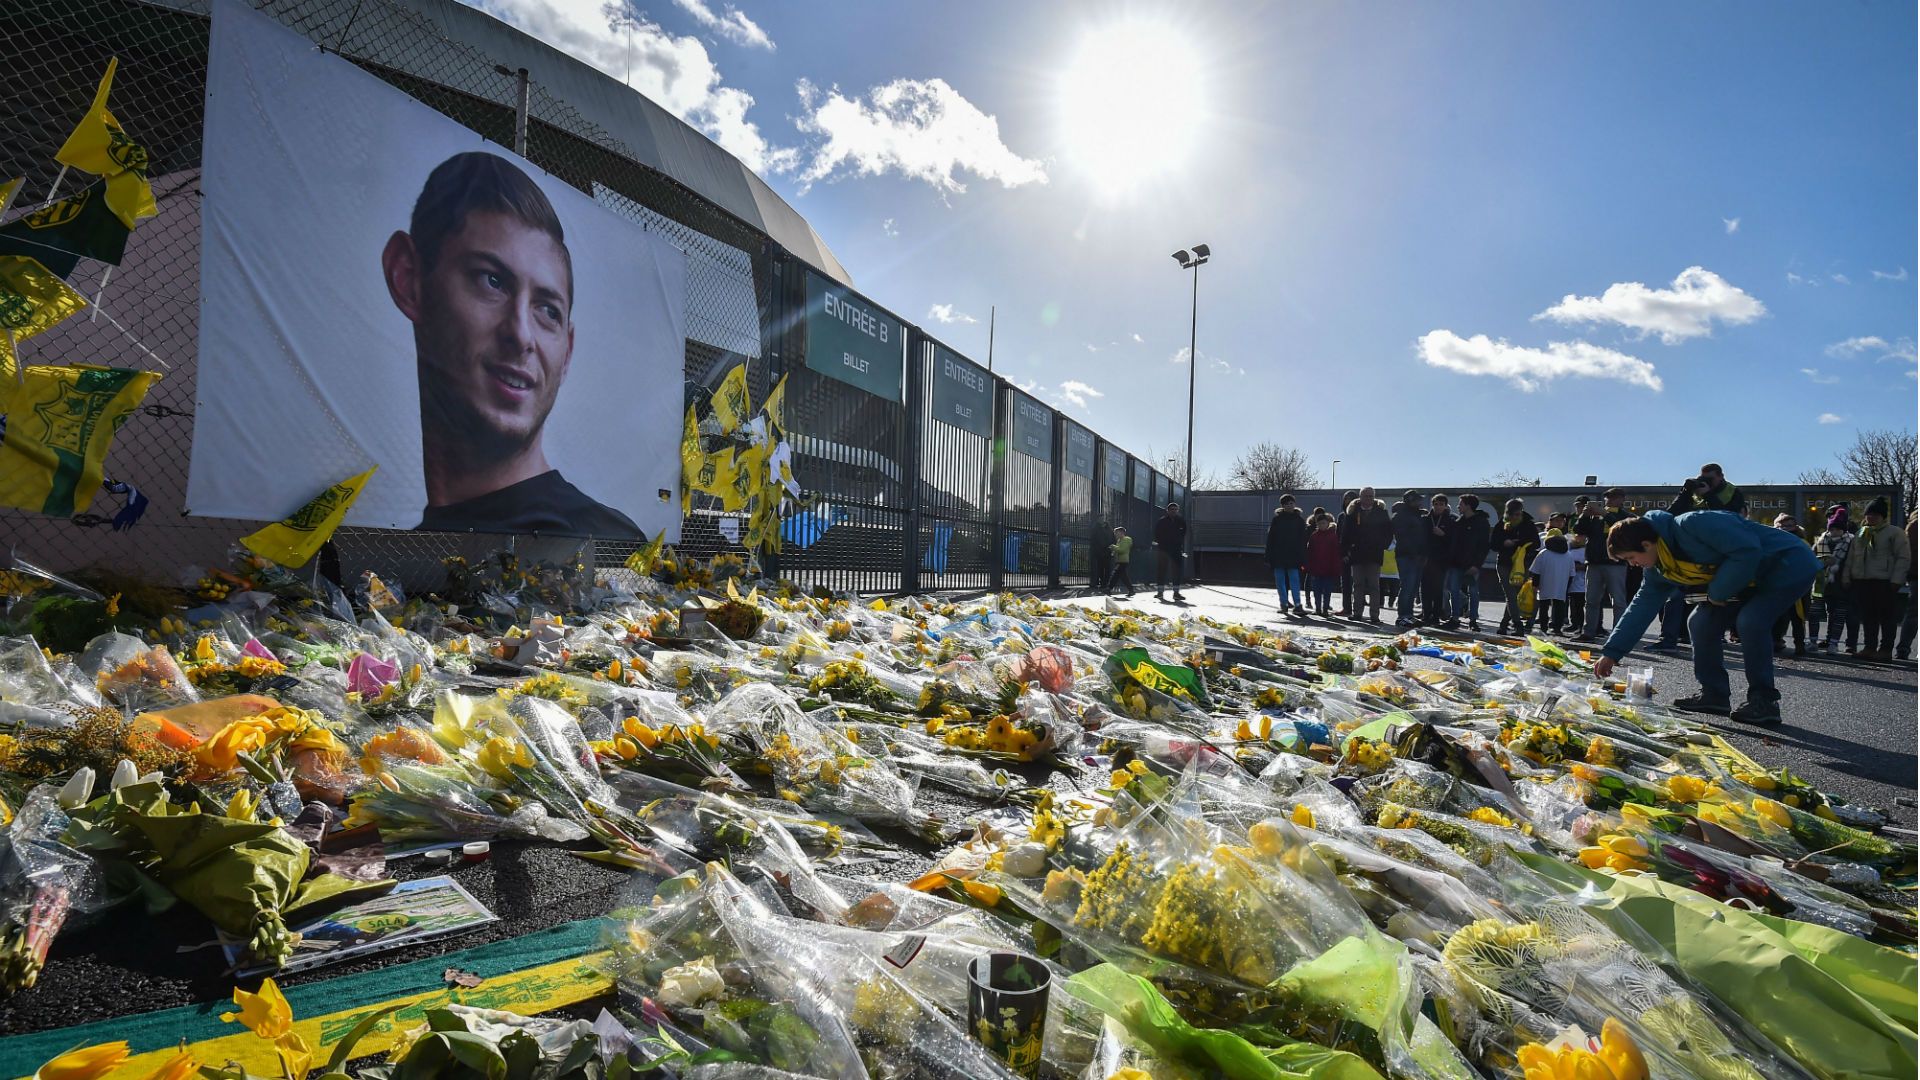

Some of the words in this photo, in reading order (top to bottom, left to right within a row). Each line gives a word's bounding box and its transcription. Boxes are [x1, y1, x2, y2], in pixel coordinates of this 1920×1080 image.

[824, 291, 876, 338] ENTRÉE
[879, 321, 889, 343] B
[843, 351, 870, 375] BILLET
[945, 358, 976, 390] ENTRÉE
[978, 375, 984, 393] B
[955, 403, 972, 419] BILLET
[1622, 500, 1672, 508] OUTIQ
[368, 917, 401, 928] SALA
